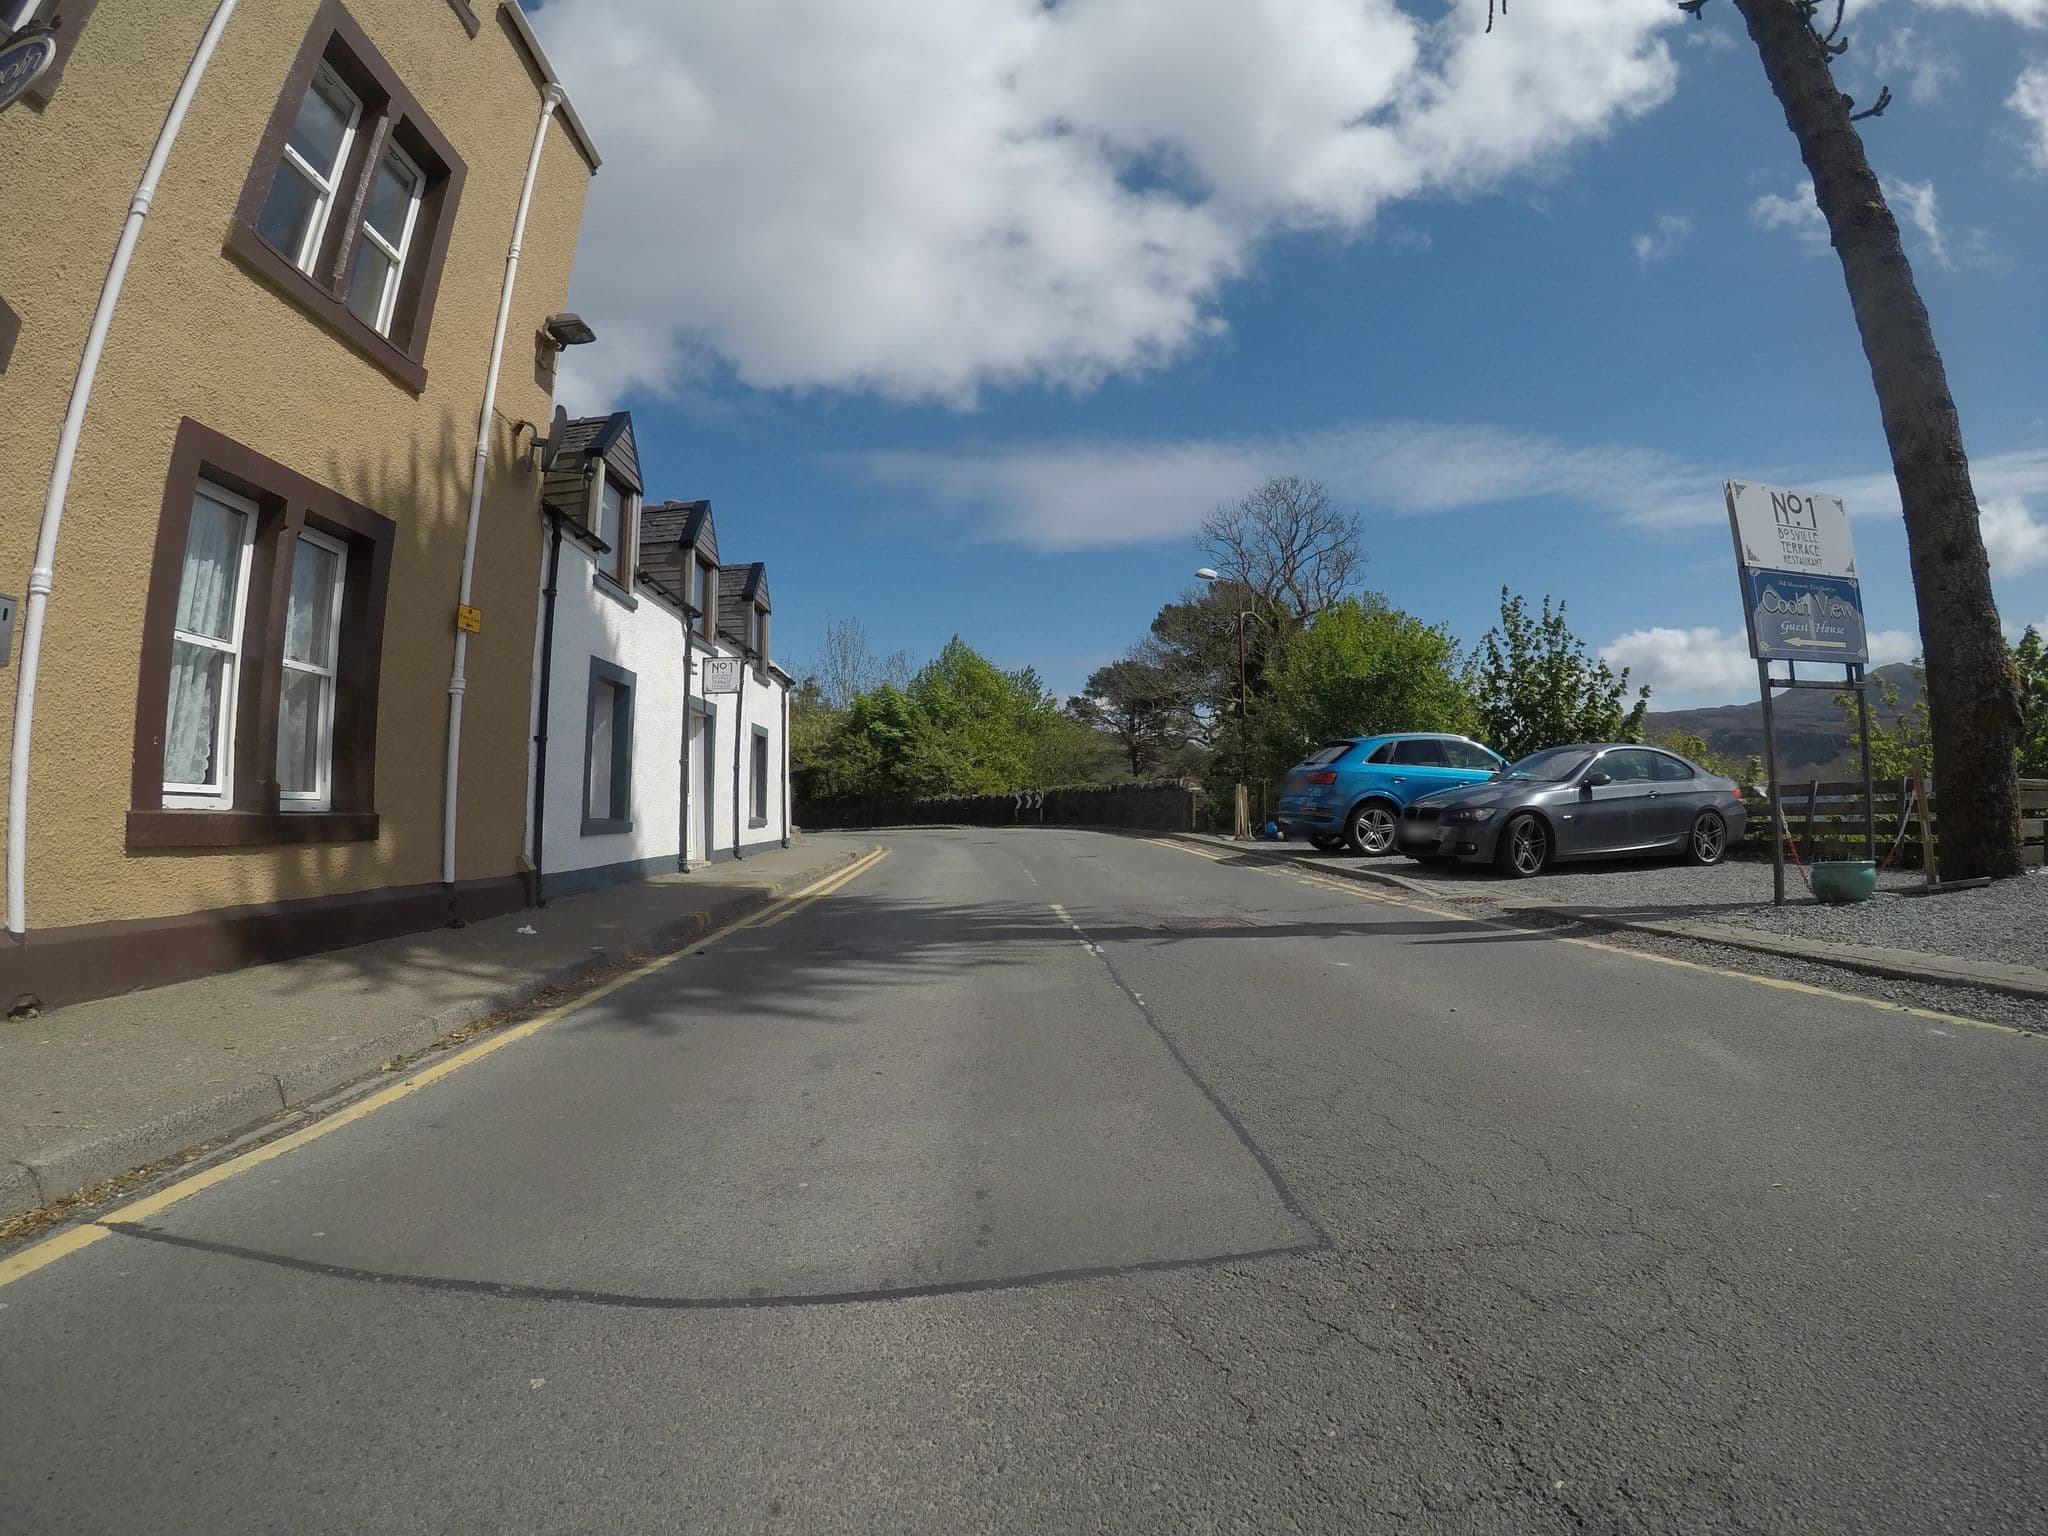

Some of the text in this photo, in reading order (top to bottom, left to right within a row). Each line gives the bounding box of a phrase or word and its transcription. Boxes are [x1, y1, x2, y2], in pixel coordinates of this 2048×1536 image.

[1778, 527, 1818, 544] BOSVILLE
[1781, 541, 1820, 557] TERRACE
[1783, 555, 1822, 567] RESTAURANT
[1762, 590, 1853, 620] Coolin View
[1781, 620, 1844, 634] Guest House
